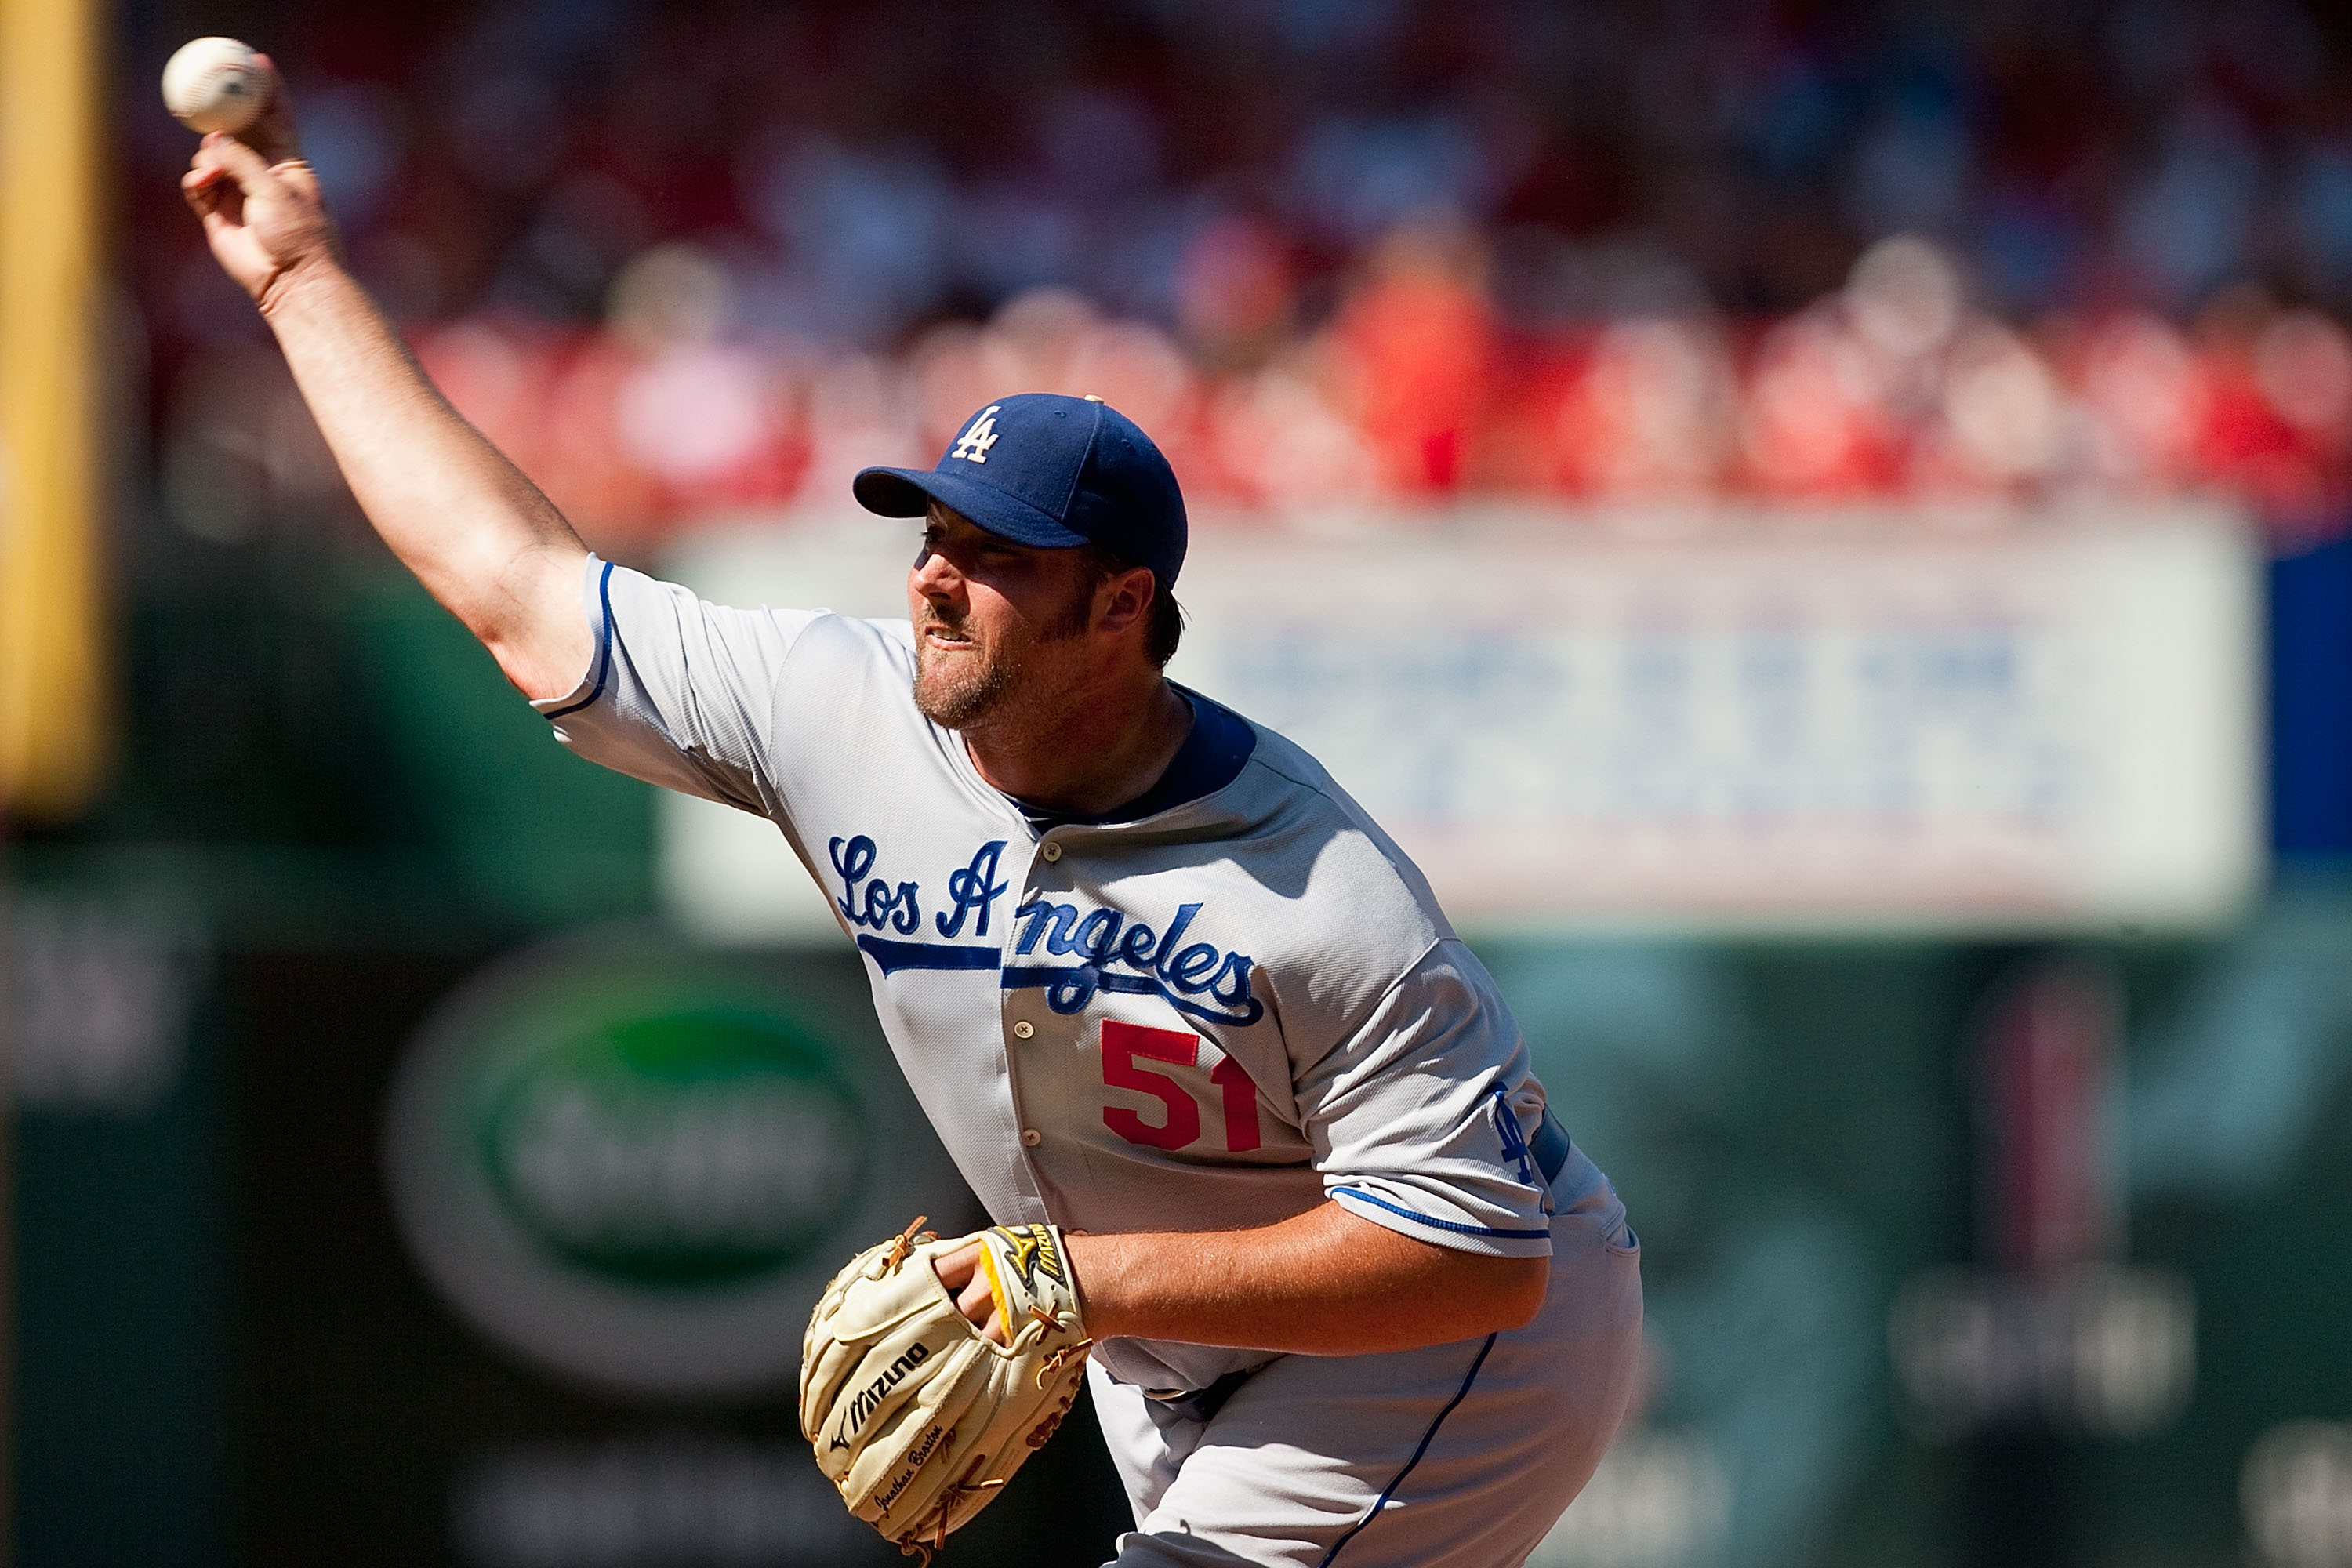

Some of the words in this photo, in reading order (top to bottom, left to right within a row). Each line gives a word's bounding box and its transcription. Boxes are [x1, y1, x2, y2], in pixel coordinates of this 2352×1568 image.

[951, 405, 1001, 464] LA
[829, 835, 920, 935] Los
[935, 840, 1254, 1015] Angeles
[1102, 1019, 1261, 1152] 51
[850, 1342, 929, 1436] MIZUNO
[874, 1468, 914, 1512] Jonathan
